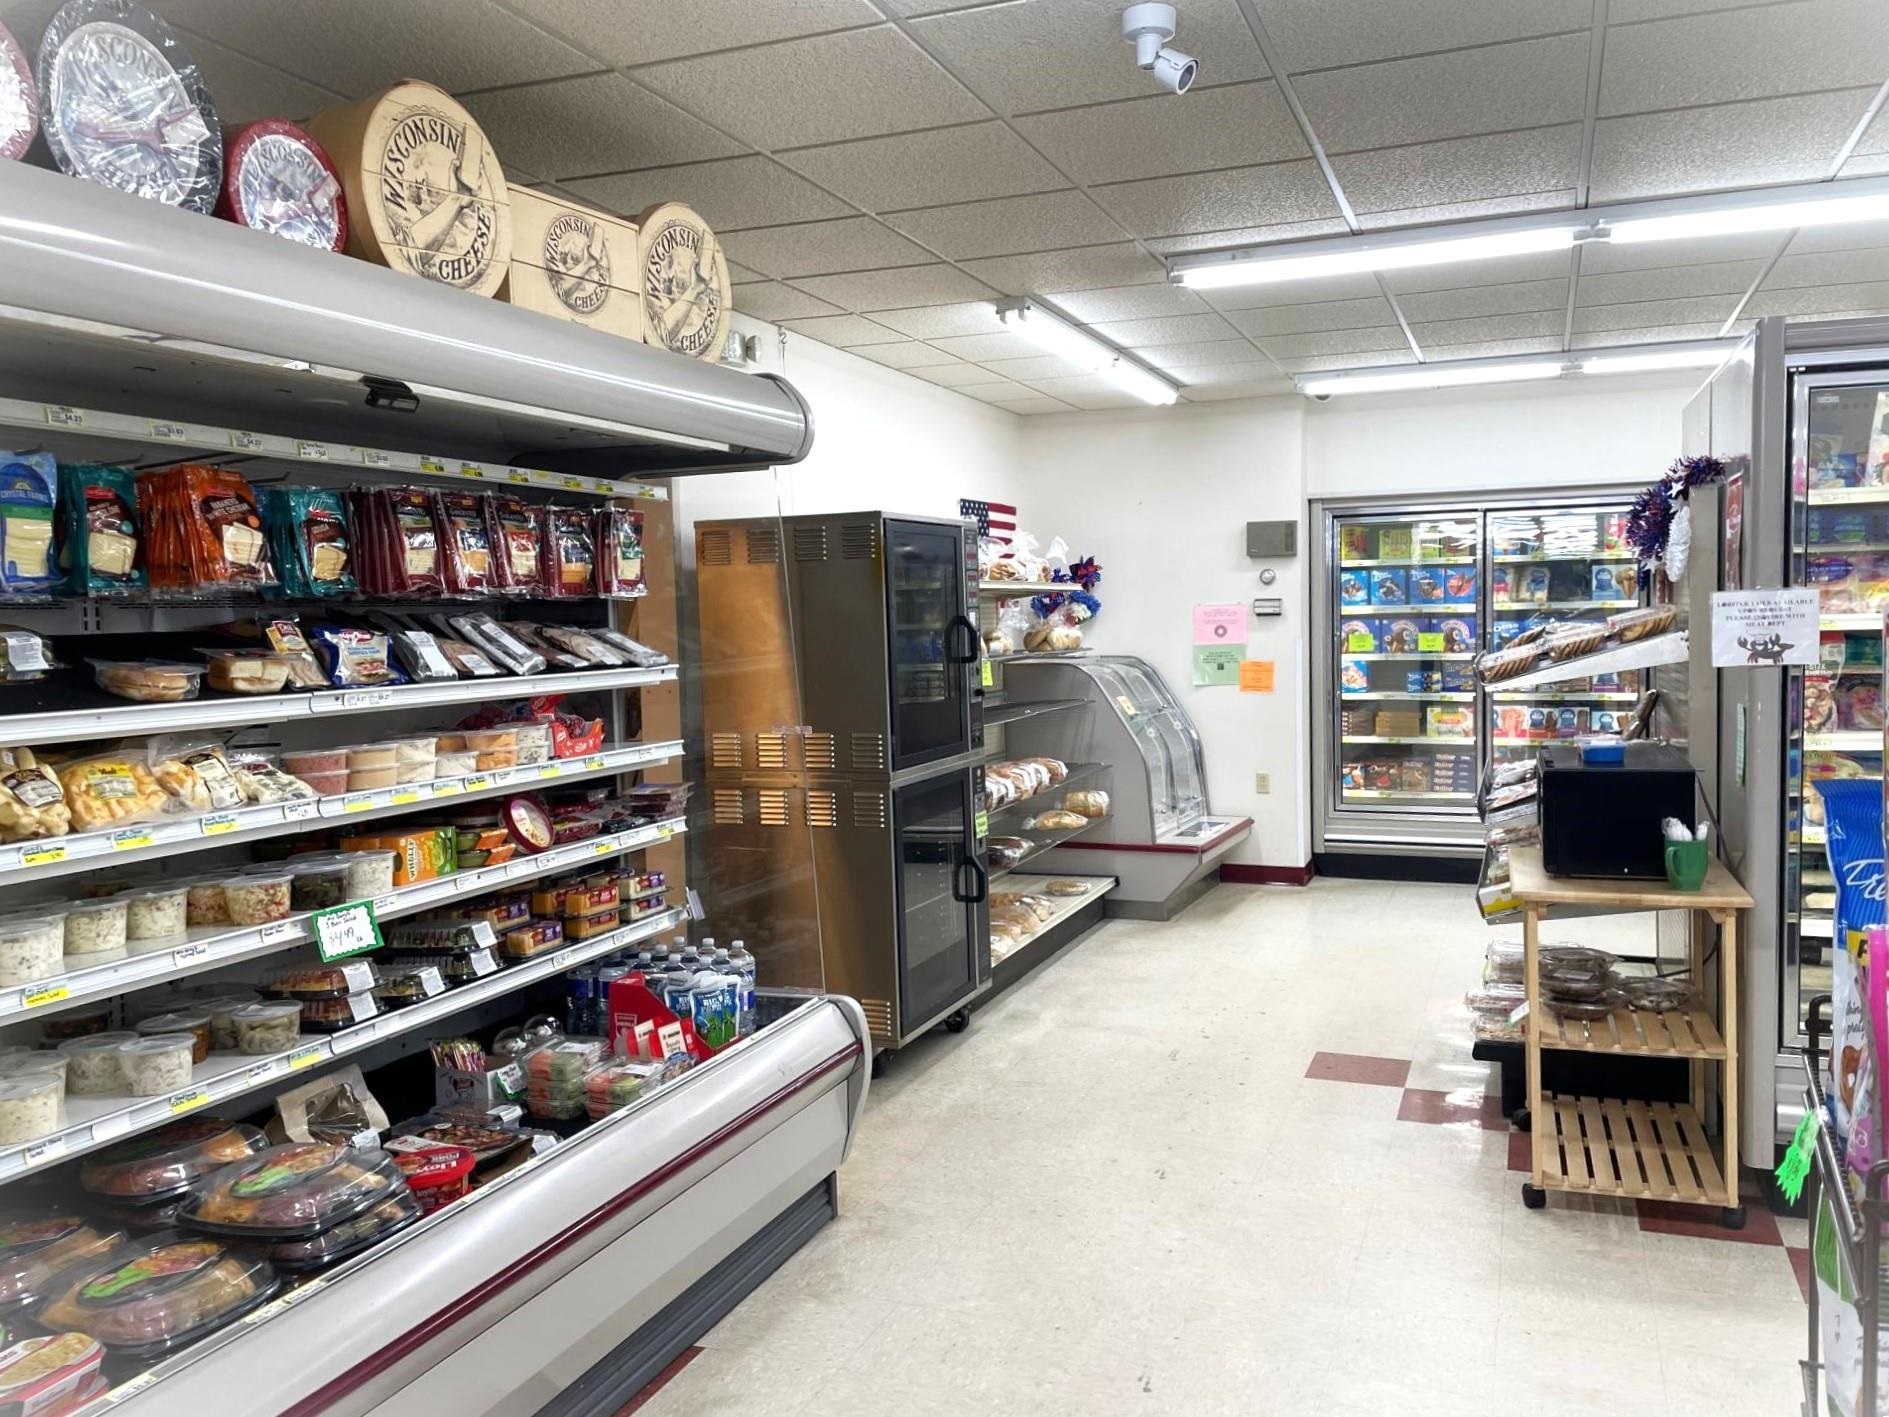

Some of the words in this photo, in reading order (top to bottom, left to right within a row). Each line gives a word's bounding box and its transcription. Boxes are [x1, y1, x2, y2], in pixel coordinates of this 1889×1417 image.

[383, 116, 460, 212] WISCONSIN
[439, 207, 491, 281] CHEESE
[546, 217, 592, 269] WISCONSIN
[646, 227, 699, 300] WISCONSIN
[681, 296, 721, 351] CHEESE
